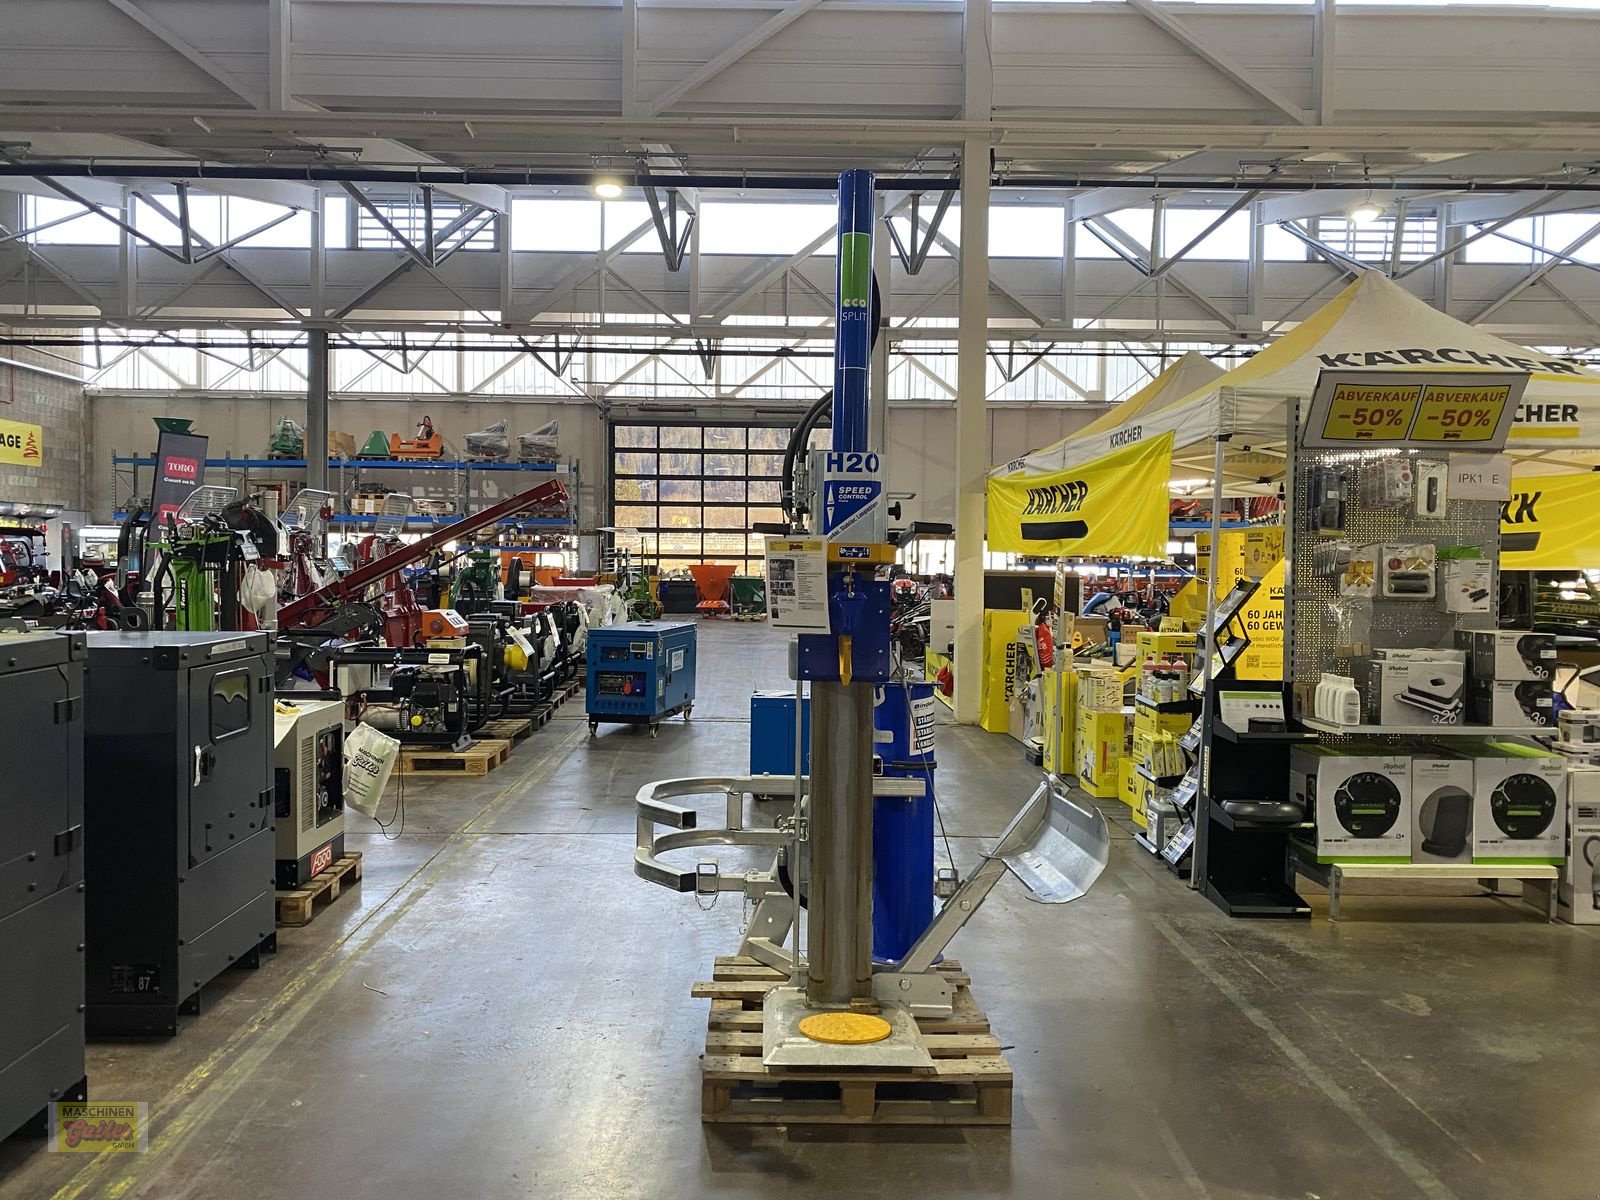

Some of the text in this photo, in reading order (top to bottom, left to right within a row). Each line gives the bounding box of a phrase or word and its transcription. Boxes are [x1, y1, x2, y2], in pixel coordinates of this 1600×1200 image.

[843, 299, 866, 307] eco
[842, 312, 866, 321] SPLIT
[1336, 391, 1417, 403] ABVERKAUF
[1425, 392, 1506, 403] ABVERKAUF
[1338, 407, 1403, 426] -50%
[1427, 408, 1491, 427] -50%
[1109, 425, 1143, 448] KÄRCHER
[168, 463, 195, 473] TORO
[826, 453, 879, 473] H20
[1458, 473, 1499, 484] IPK1 E
[1022, 480, 1089, 514] KÄRCHER
[1247, 610, 1260, 619] 60
[1247, 621, 1260, 630] 60
[1432, 710, 1457, 724] 320
[139, 976, 150, 991] 87
